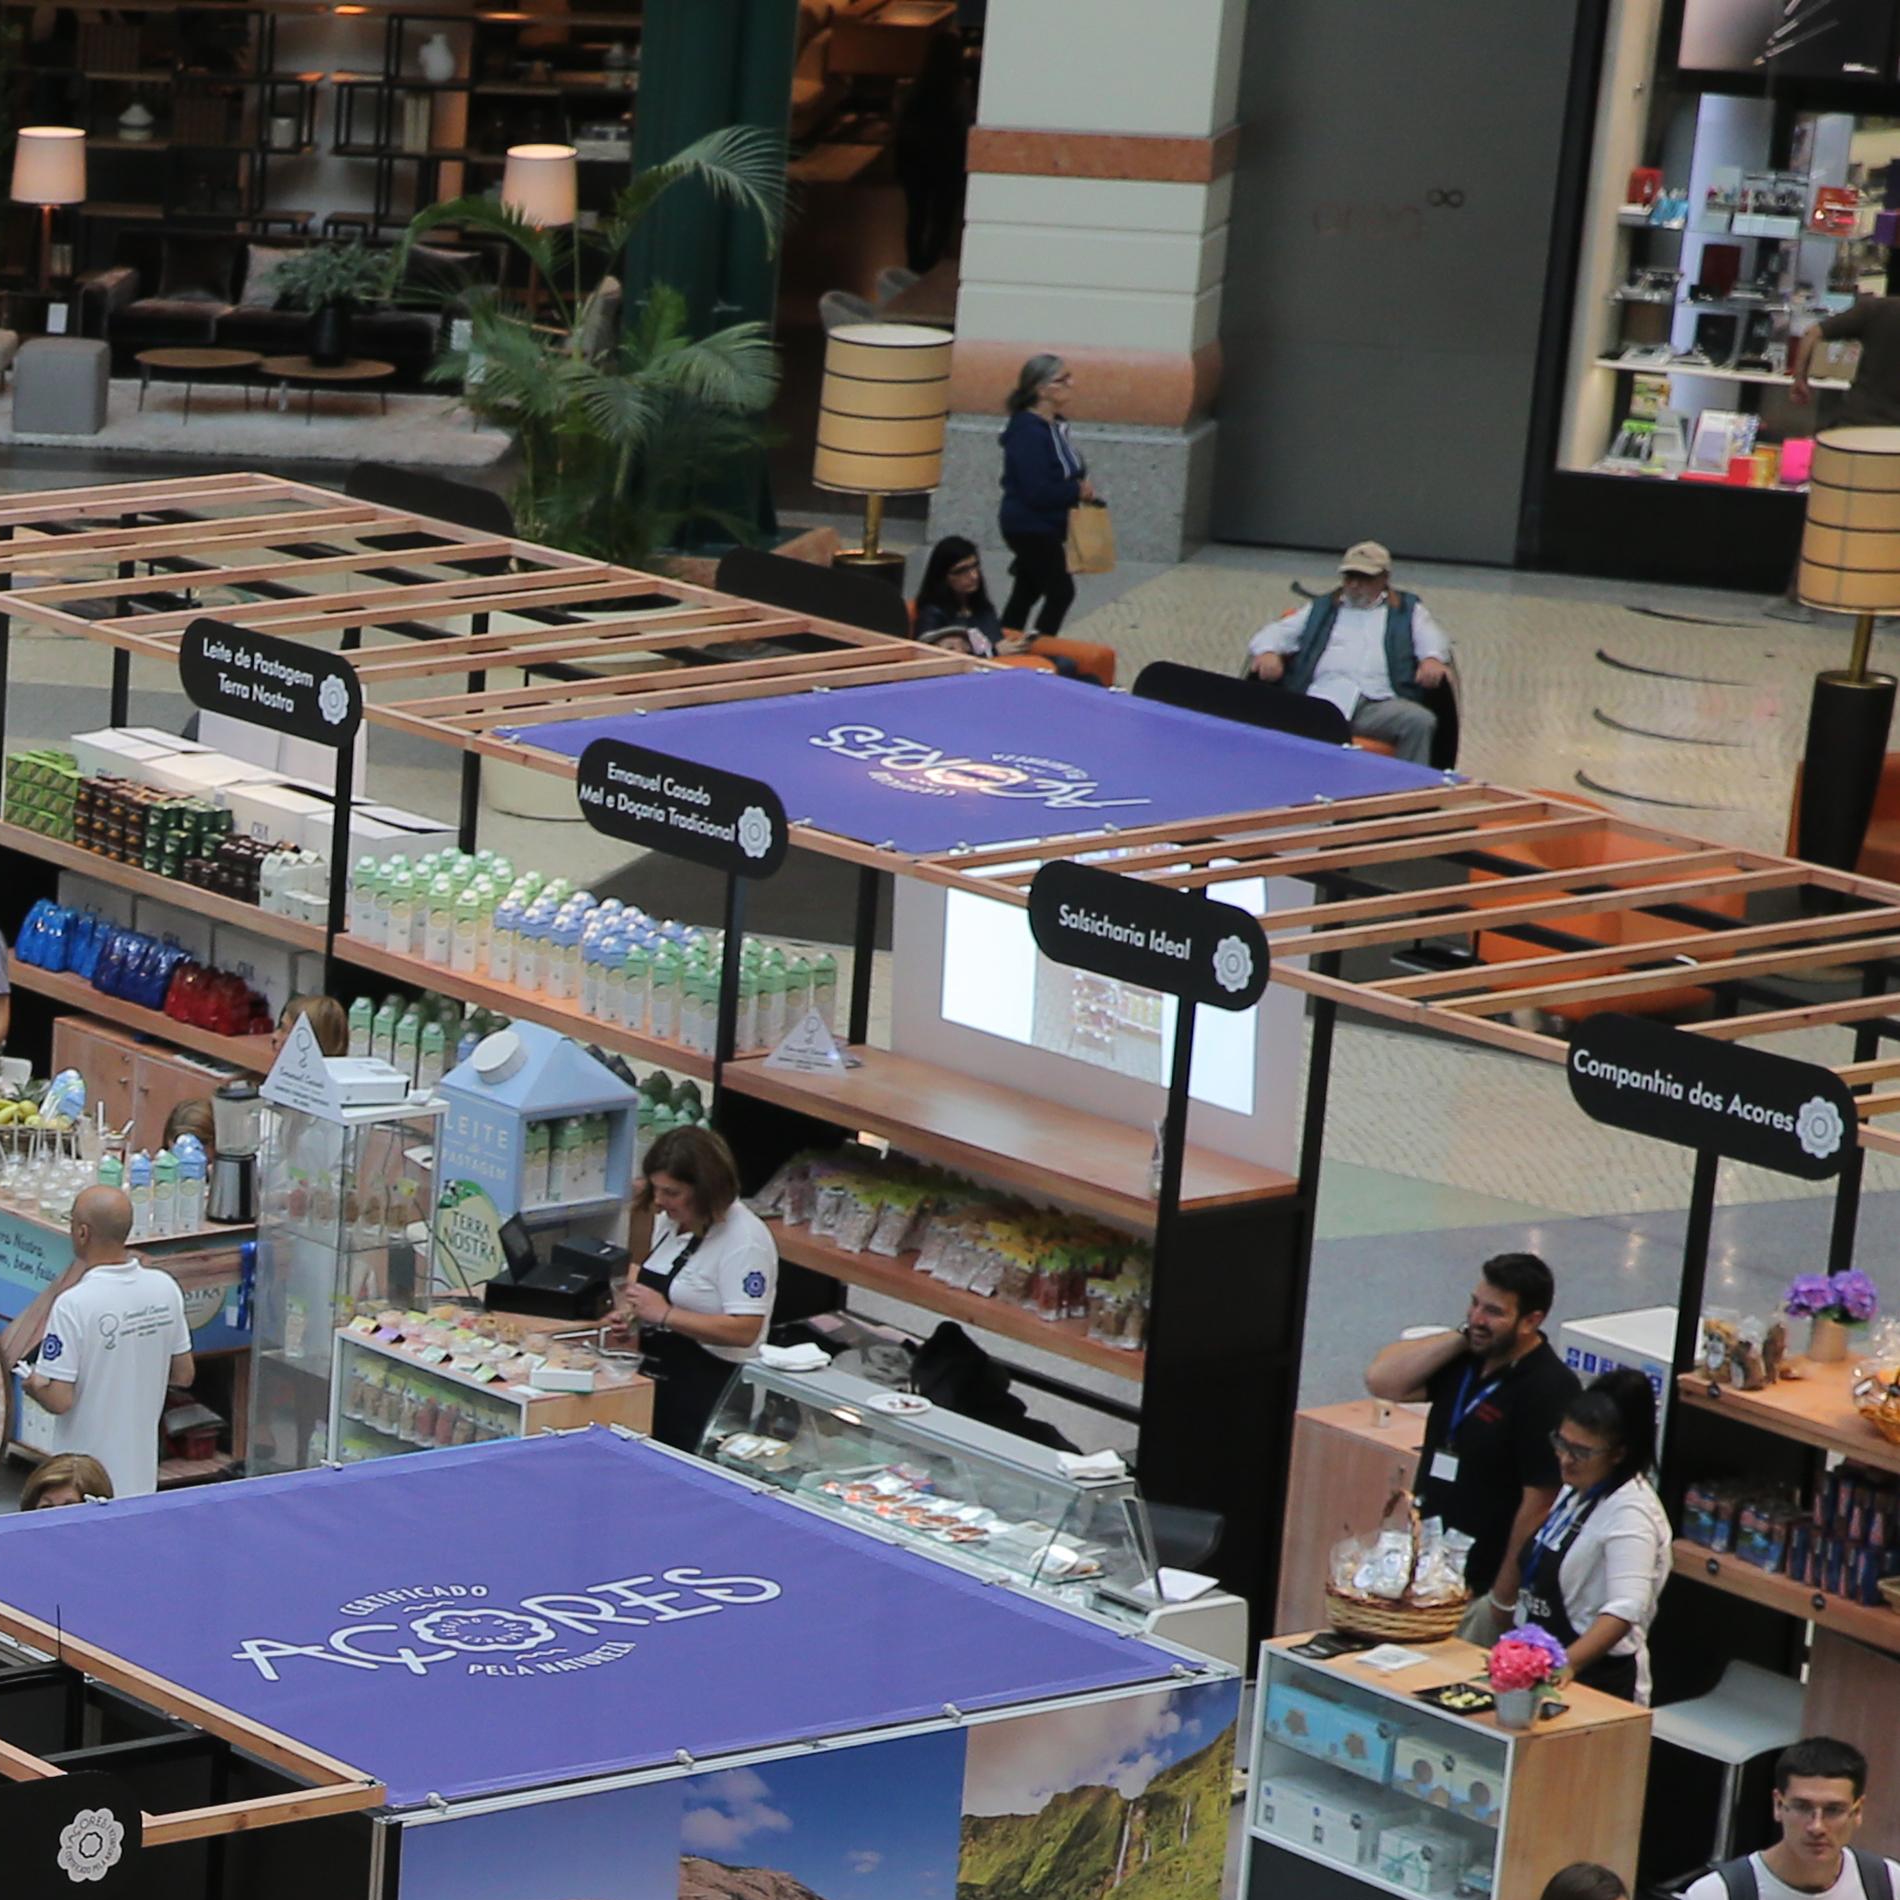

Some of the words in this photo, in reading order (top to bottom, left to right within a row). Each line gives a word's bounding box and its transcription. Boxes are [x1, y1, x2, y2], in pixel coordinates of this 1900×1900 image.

[203, 637, 232, 662] Leite
[235, 646, 251, 667] de
[253, 651, 314, 693] Pastagem
[218, 672, 253, 704] Terra
[253, 684, 295, 713] Nostra
[607, 762, 661, 794] Emanuel
[663, 778, 711, 808] Casado
[580, 782, 604, 804] Mel
[605, 795, 615, 809] e
[617, 795, 666, 824] Doçaria
[668, 811, 736, 842] Tradicional
[1059, 904, 1145, 949] Salsicharia
[1150, 928, 1191, 961] Ideal
[1573, 1047, 1683, 1107] Companhia
[1688, 1078, 1722, 1113] dos
[1727, 1093, 1795, 1133] Acores
[443, 1111, 509, 1149] LEITE
[340, 1582, 489, 1616] CERTIFICADO
[232, 1568, 783, 1682] AÇORES
[467, 1661, 516, 1678] PELA
[518, 1640, 637, 1677] NATUREZA
